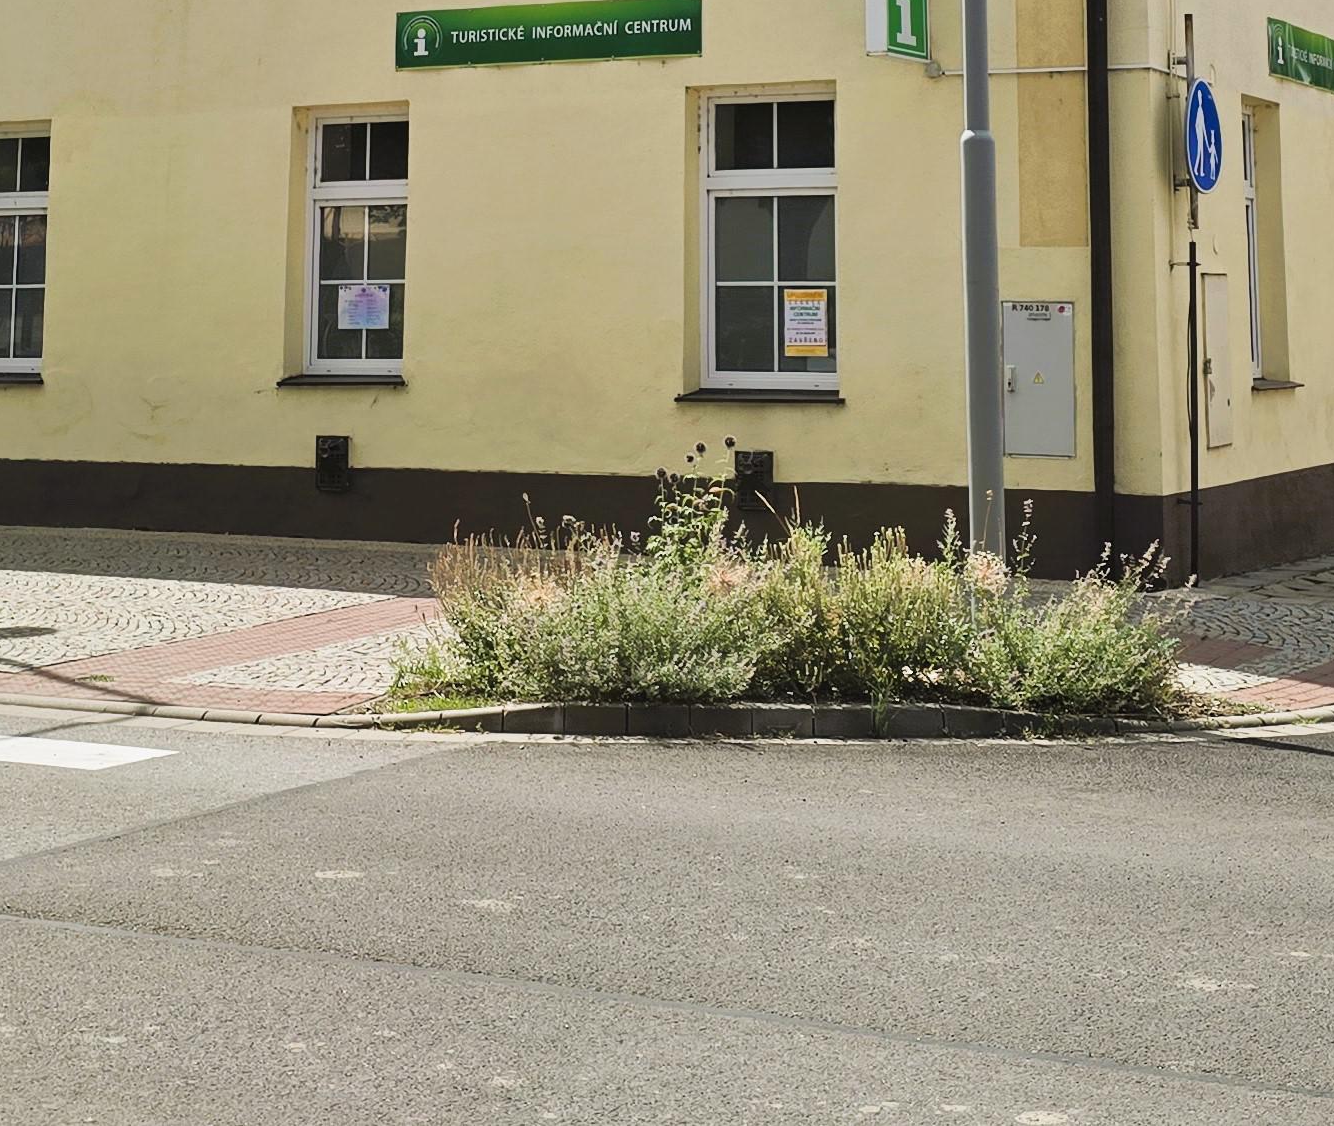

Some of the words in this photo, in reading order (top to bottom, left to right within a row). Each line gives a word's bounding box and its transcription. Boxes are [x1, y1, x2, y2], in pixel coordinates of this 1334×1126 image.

[451, 26, 525, 44] TURISTICKÉ
[532, 20, 618, 39] INFORMAČNÍ
[625, 18, 692, 35] CENTRUM
